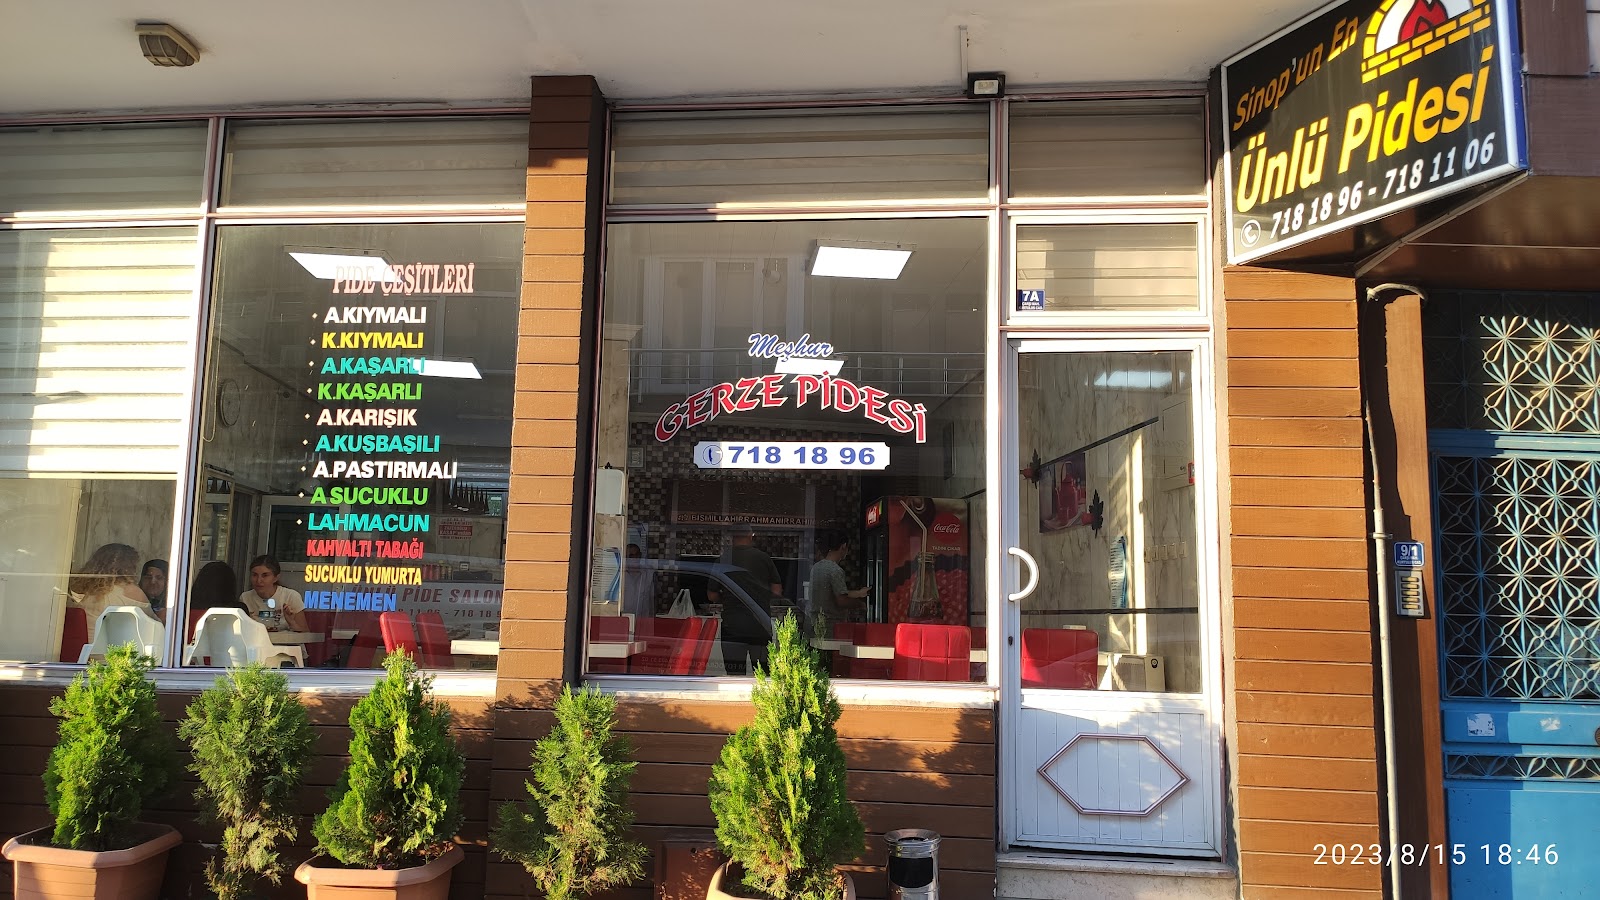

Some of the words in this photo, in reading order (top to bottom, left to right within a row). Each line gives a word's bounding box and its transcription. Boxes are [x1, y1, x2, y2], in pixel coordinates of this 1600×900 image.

[1328, 17, 1358, 62] En
[1236, 117, 1329, 213] Ünlü
[1338, 45, 1494, 175] Pidesi
[1270, 203, 1304, 240] 718
[1308, 192, 1333, 225] 18
[1337, 180, 1363, 216] 96
[1368, 187, 1377, 196] -
[1382, 158, 1424, 200] 718
[1429, 146, 1456, 183] 11
[1465, 131, 1496, 170] 06
[380, 263, 475, 296] ÇEŞİTLERİ
[1022, 291, 1040, 302] 7A
[323, 307, 427, 323] A.KIYMALI
[321, 332, 424, 348] K.KIYMALI
[748, 333, 833, 362] Meşhur
[320, 357, 425, 376] A.KAŞARLI
[317, 383, 422, 402] K.KAŞARLI
[655, 374, 788, 442] GERZE
[790, 370, 927, 443] PİDESİ
[316, 409, 417, 428] A.KARIŞIK
[315, 435, 440, 454] A.KUŞBAŞILI
[728, 446, 781, 464] 718
[793, 446, 828, 464] 18
[839, 447, 876, 465] 96
[312, 461, 457, 479] A.PASTIRMALI
[330, 487, 428, 505] SUCUKLU
[307, 513, 429, 532] LAHMACUN
[306, 539, 372, 557] KAHVALTI
[375, 537, 424, 559] TABAĞI
[1401, 545, 1418, 556] 9/1
[304, 565, 361, 583] SUCUKLU
[364, 566, 422, 585] YUMURTA
[303, 590, 396, 611] MENEMEN
[402, 586, 443, 603] PİDE
[453, 609, 474, 618] 718
[479, 610, 493, 619] 18
